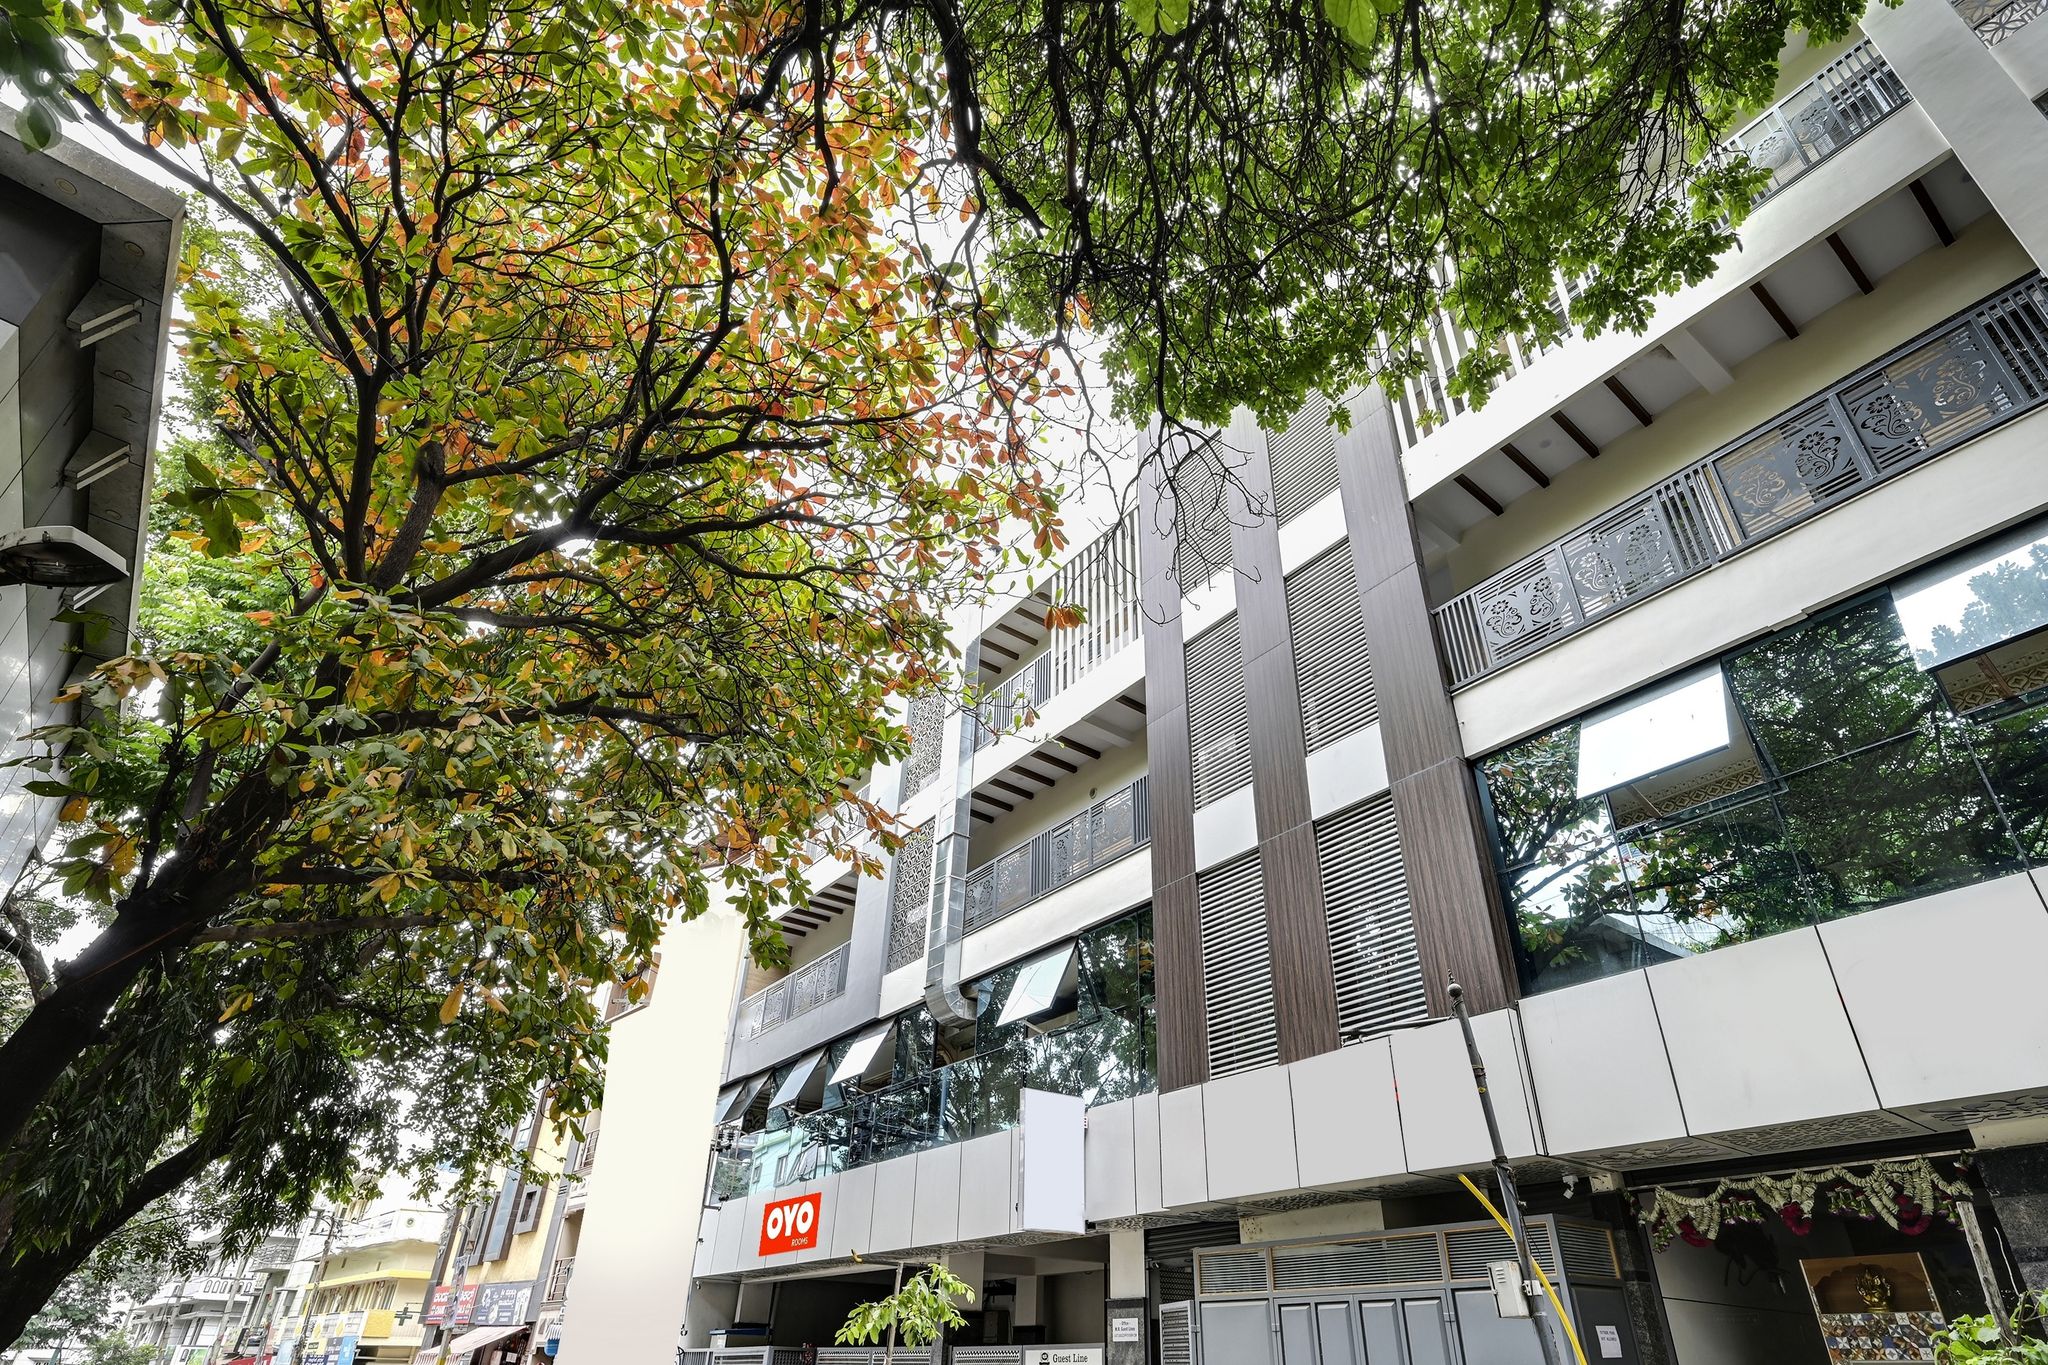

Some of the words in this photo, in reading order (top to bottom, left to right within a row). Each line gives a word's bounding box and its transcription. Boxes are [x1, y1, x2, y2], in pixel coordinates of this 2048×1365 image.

[767, 1201, 814, 1239] OYO
[791, 1237, 808, 1247] ROOMS
[1052, 1354, 1071, 1363] Guest
[1073, 1353, 1088, 1363] Line
